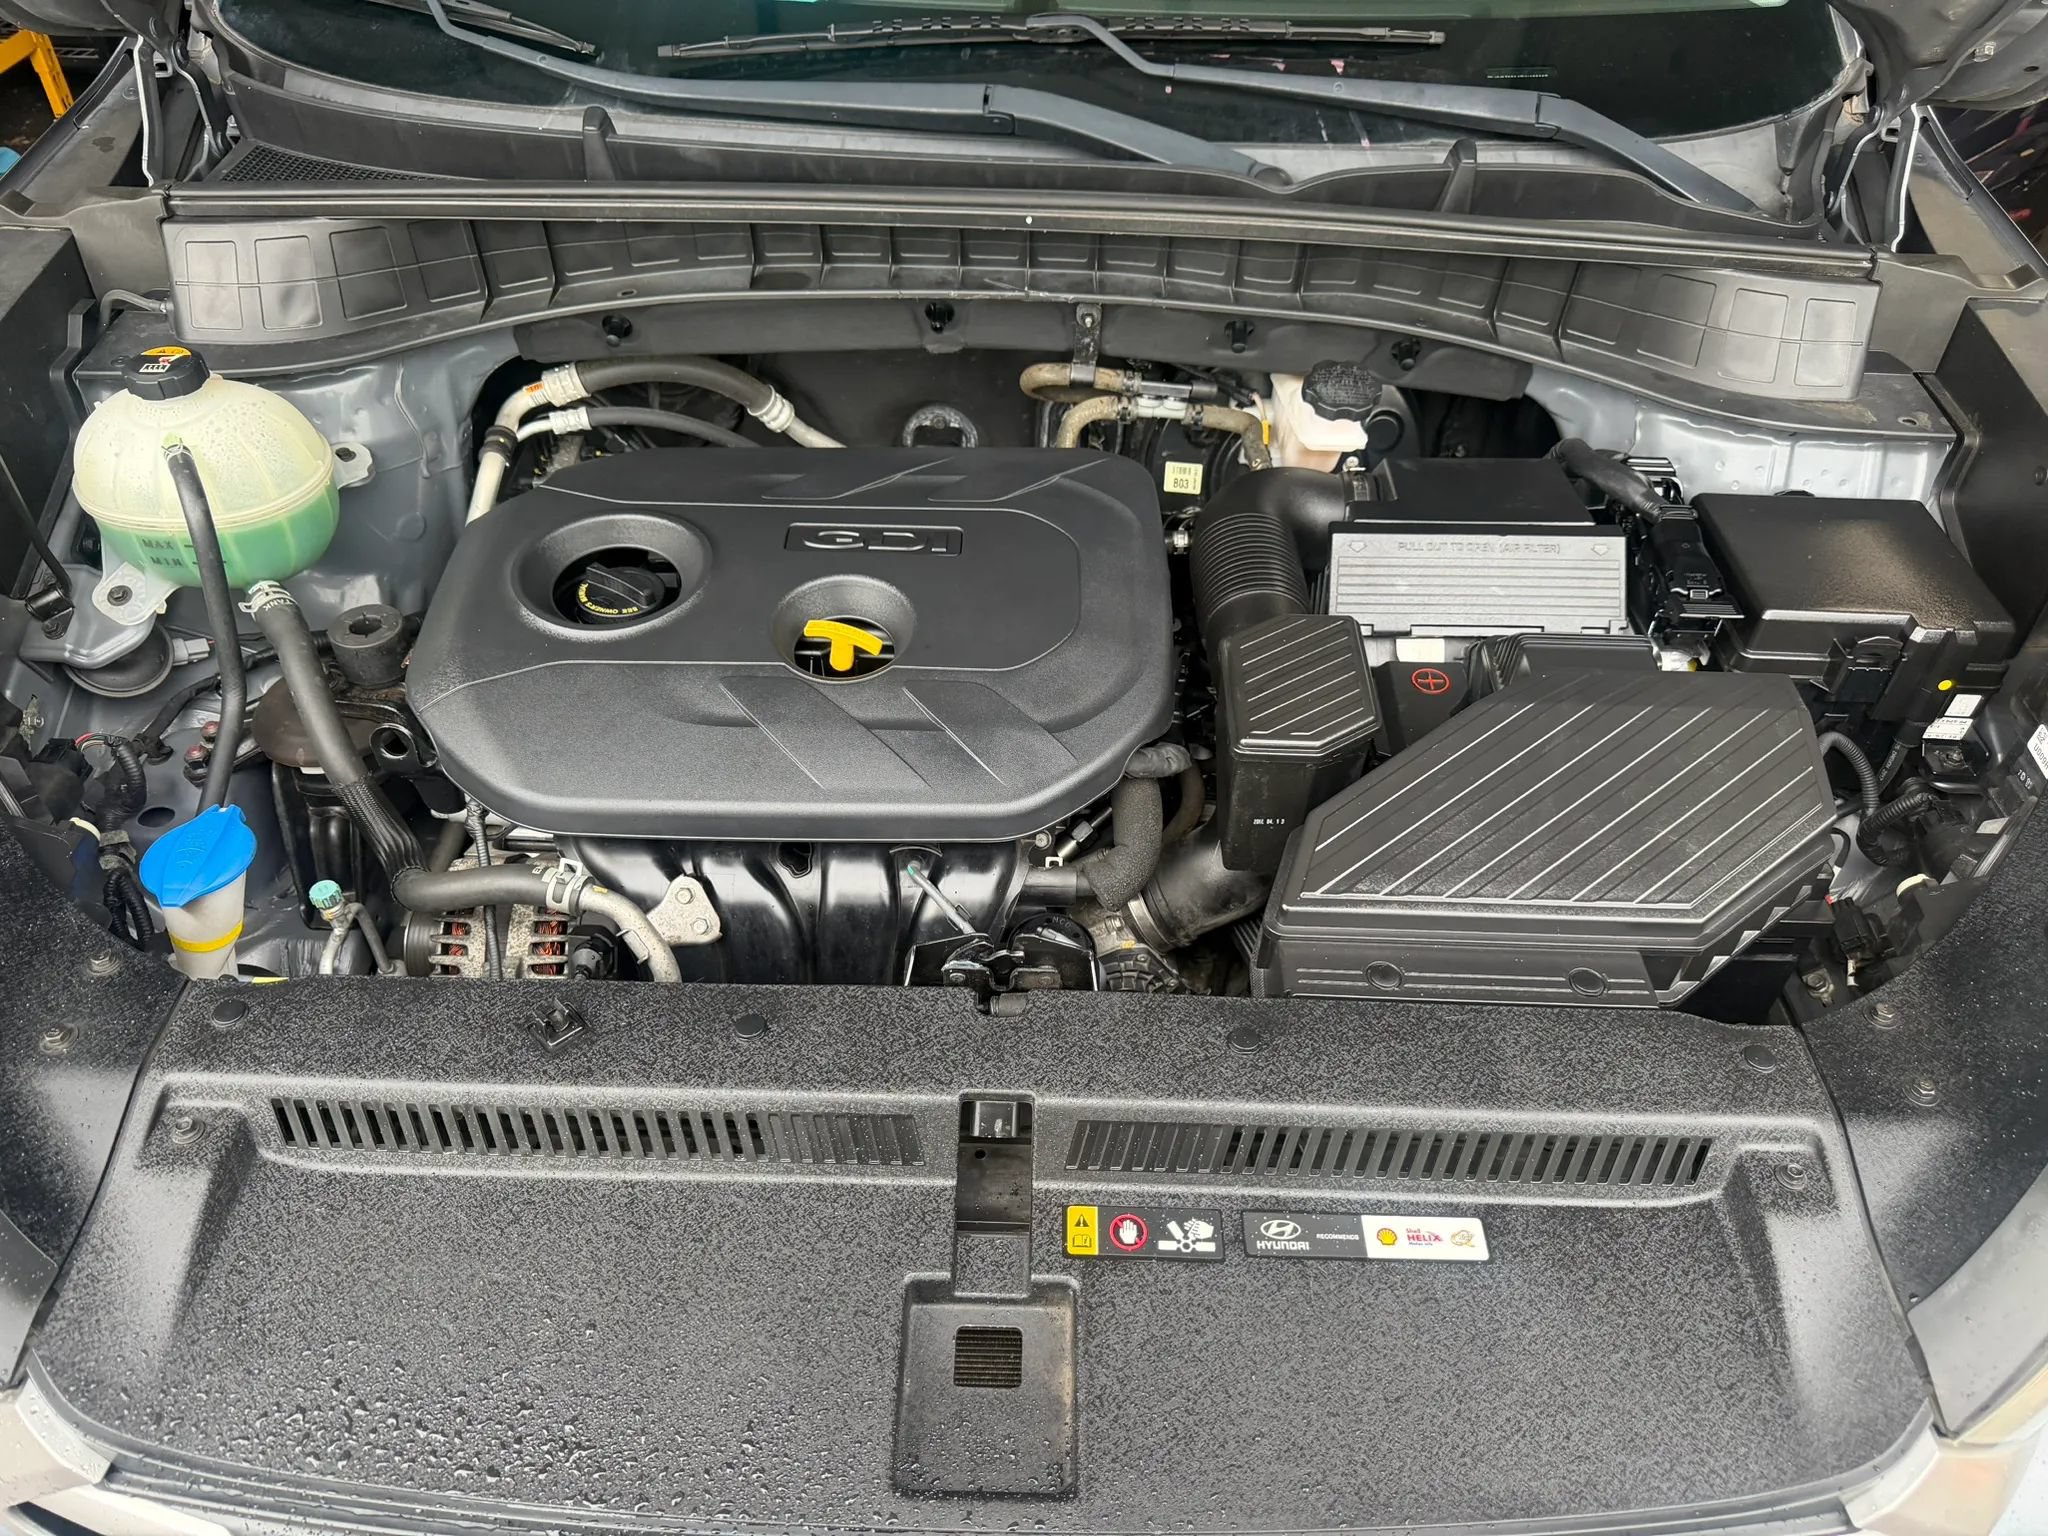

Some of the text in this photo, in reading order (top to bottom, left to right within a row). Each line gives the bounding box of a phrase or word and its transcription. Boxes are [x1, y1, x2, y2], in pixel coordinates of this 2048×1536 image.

[142, 538, 174, 550] MAX
[151, 555, 183, 567] MIN
[1406, 1233, 1441, 1242] HELIX
[1256, 1240, 1310, 1251] HYUNDAI
